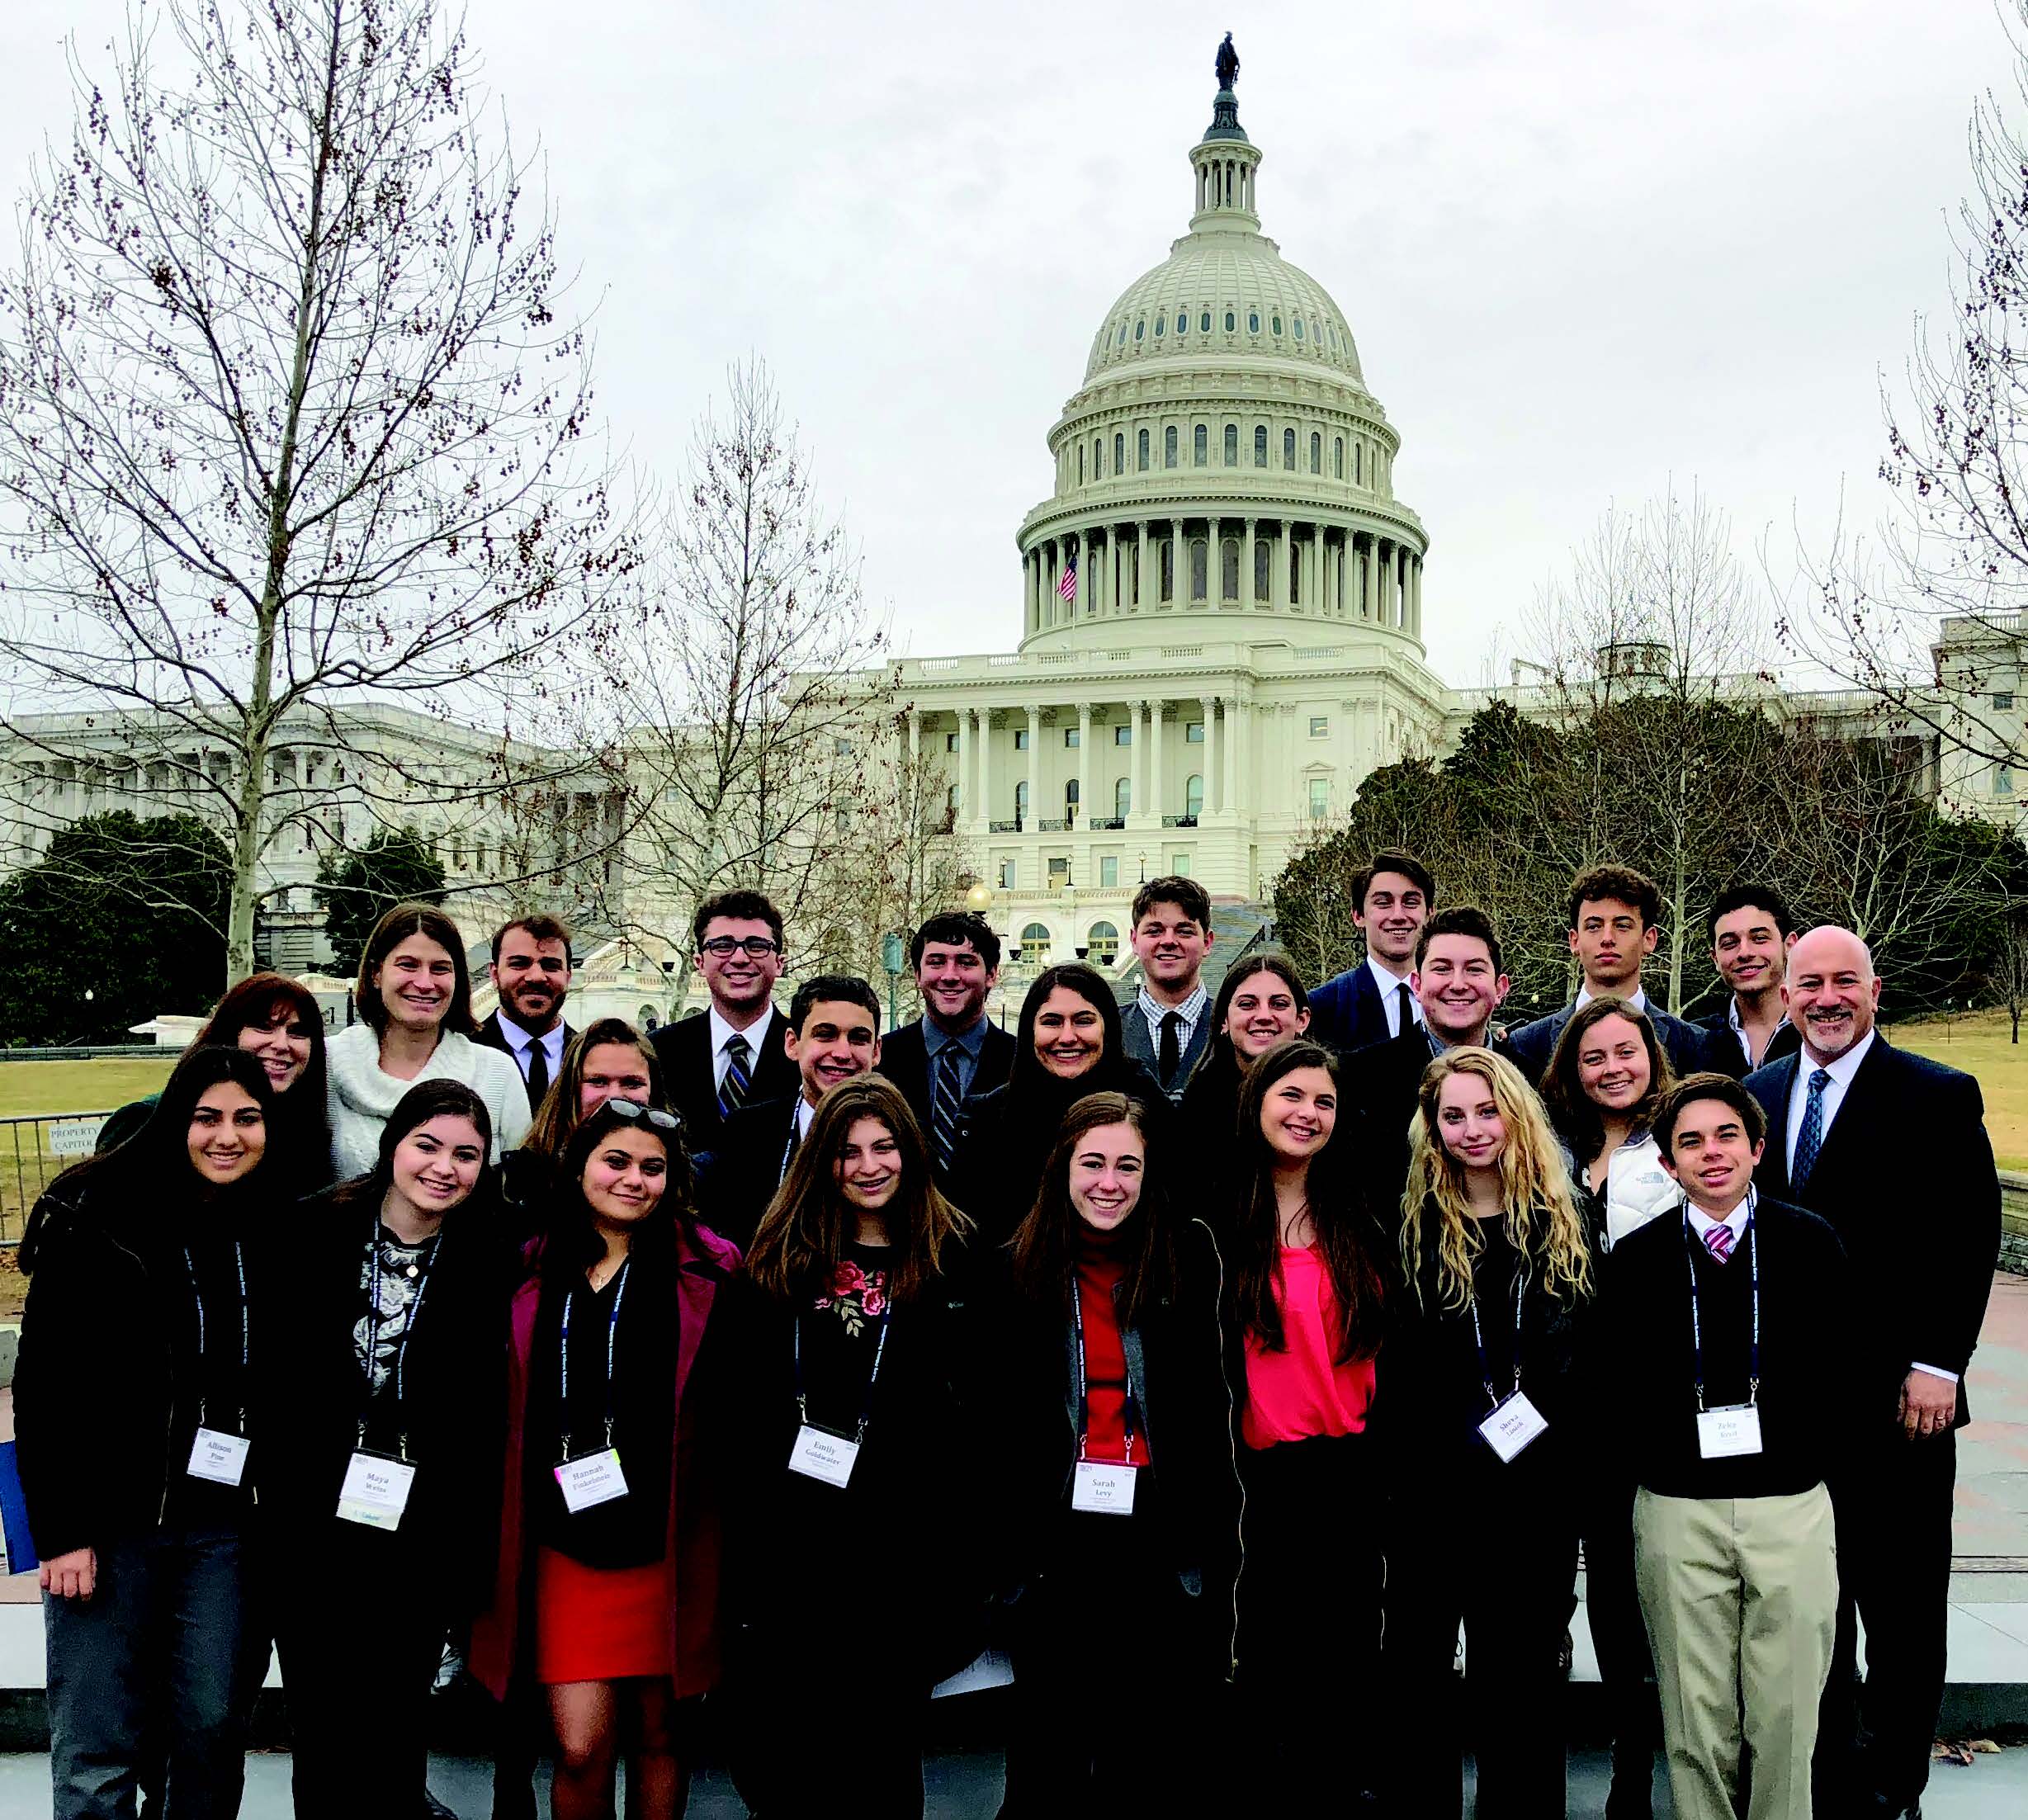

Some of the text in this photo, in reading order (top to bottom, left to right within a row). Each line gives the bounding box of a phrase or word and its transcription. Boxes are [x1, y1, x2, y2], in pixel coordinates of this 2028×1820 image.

[51, 1127, 97, 1138] PROPERTY
[54, 1140, 93, 1149] CAPITOL
[814, 1441, 835, 1455] Emily
[573, 1465, 604, 1480] Hannah
[366, 1473, 390, 1484] Maya
[1092, 1479, 1115, 1487] Sarah
